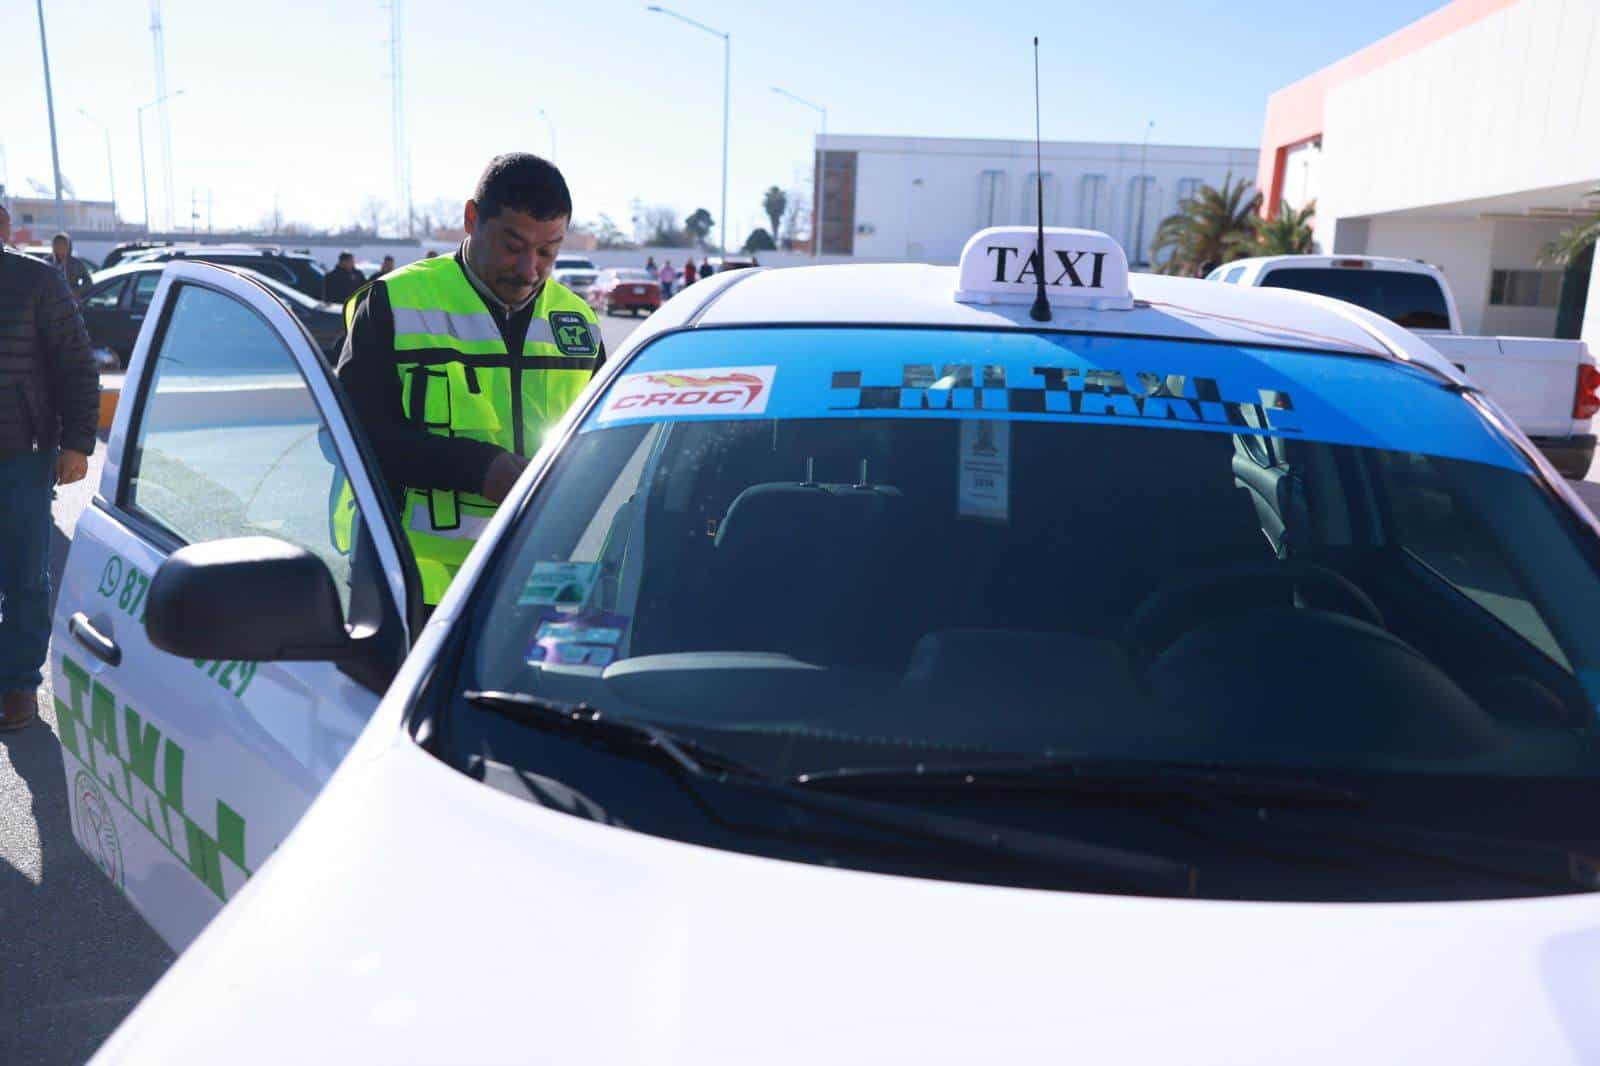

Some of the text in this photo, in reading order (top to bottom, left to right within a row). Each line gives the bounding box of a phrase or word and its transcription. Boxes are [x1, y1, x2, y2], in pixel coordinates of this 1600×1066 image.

[987, 246, 1108, 288] TAXI
[611, 390, 743, 410] CROC
[902, 364, 1229, 423] MI TAXI
[119, 567, 148, 624] 87
[63, 653, 192, 866] TAXI
